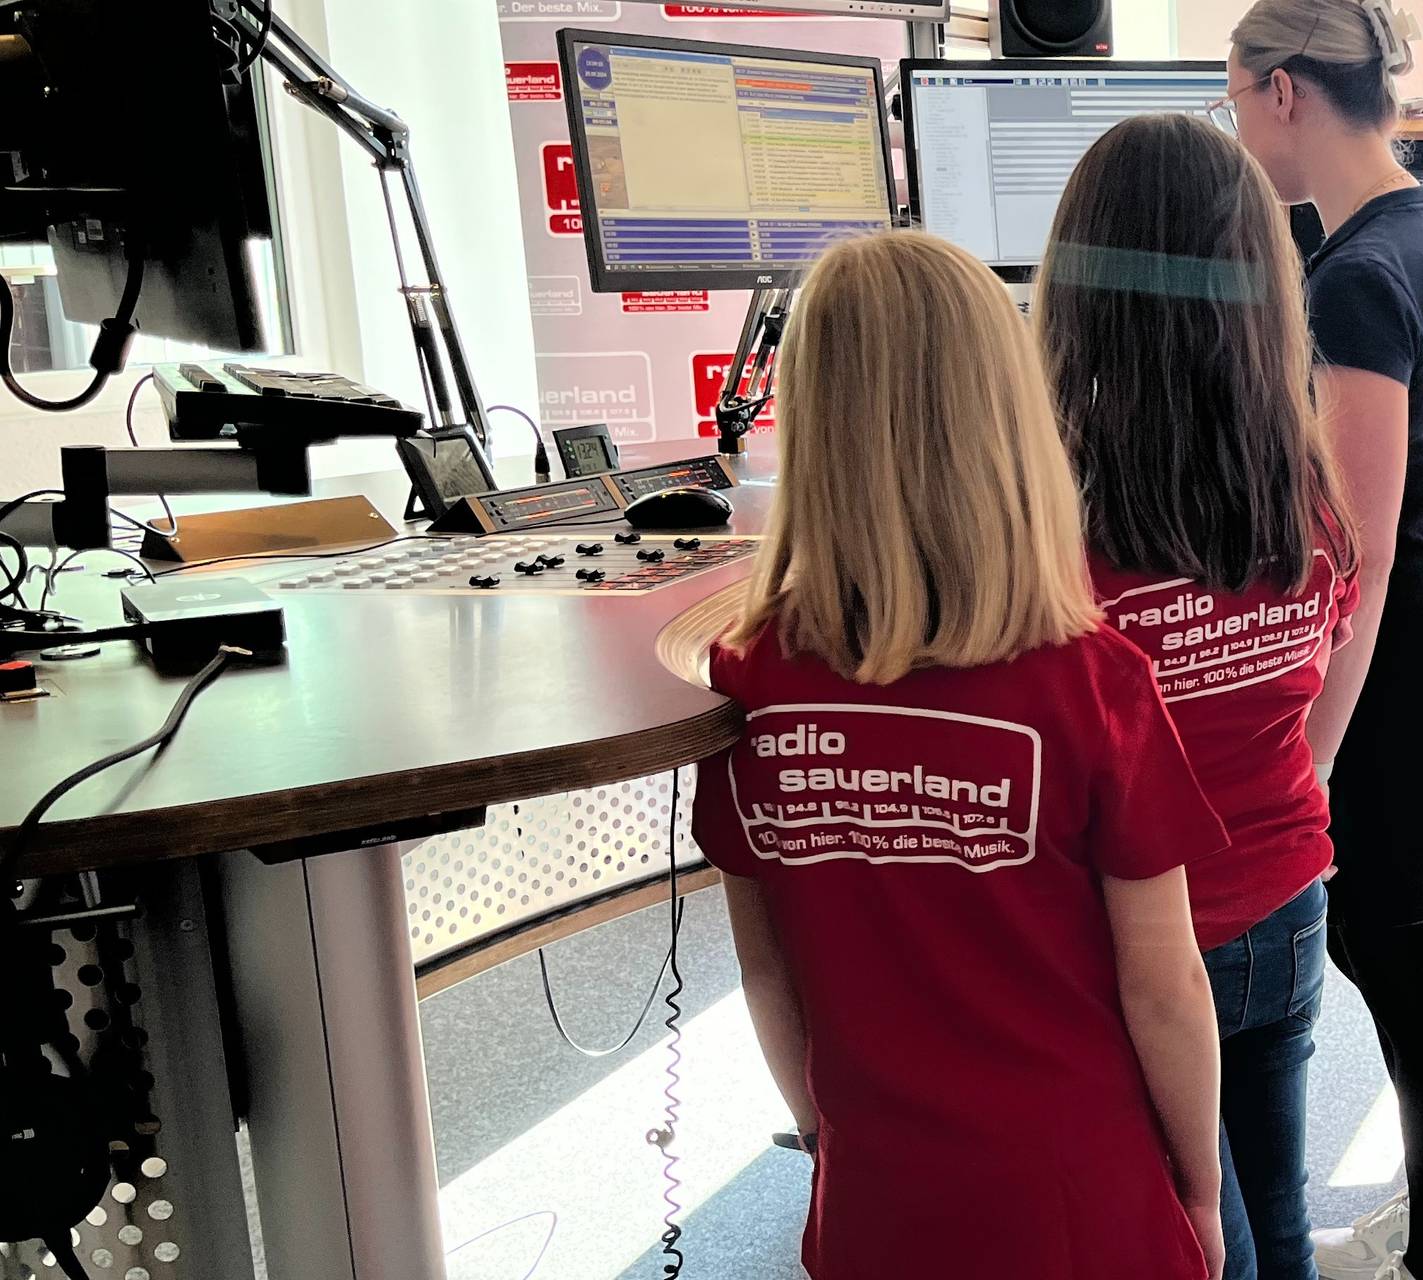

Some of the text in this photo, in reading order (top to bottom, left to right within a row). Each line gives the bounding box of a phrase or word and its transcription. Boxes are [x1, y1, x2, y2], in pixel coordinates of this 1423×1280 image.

[511, 1, 535, 13] Der
[538, 1, 574, 13] beste
[577, 1, 603, 13] Mix.
[757, 275, 773, 284] AOC
[1118, 593, 1214, 631] radio
[1161, 592, 1321, 651] sauerland
[1174, 677, 1200, 691] hier.
[1239, 663, 1255, 677] die
[1256, 656, 1283, 671] beste
[751, 723, 846, 757] adio
[778, 765, 1011, 808] sauerland
[786, 802, 818, 814] 94.8
[810, 831, 846, 848] hier.
[893, 834, 918, 849] die
[963, 840, 1016, 859] Musik.
